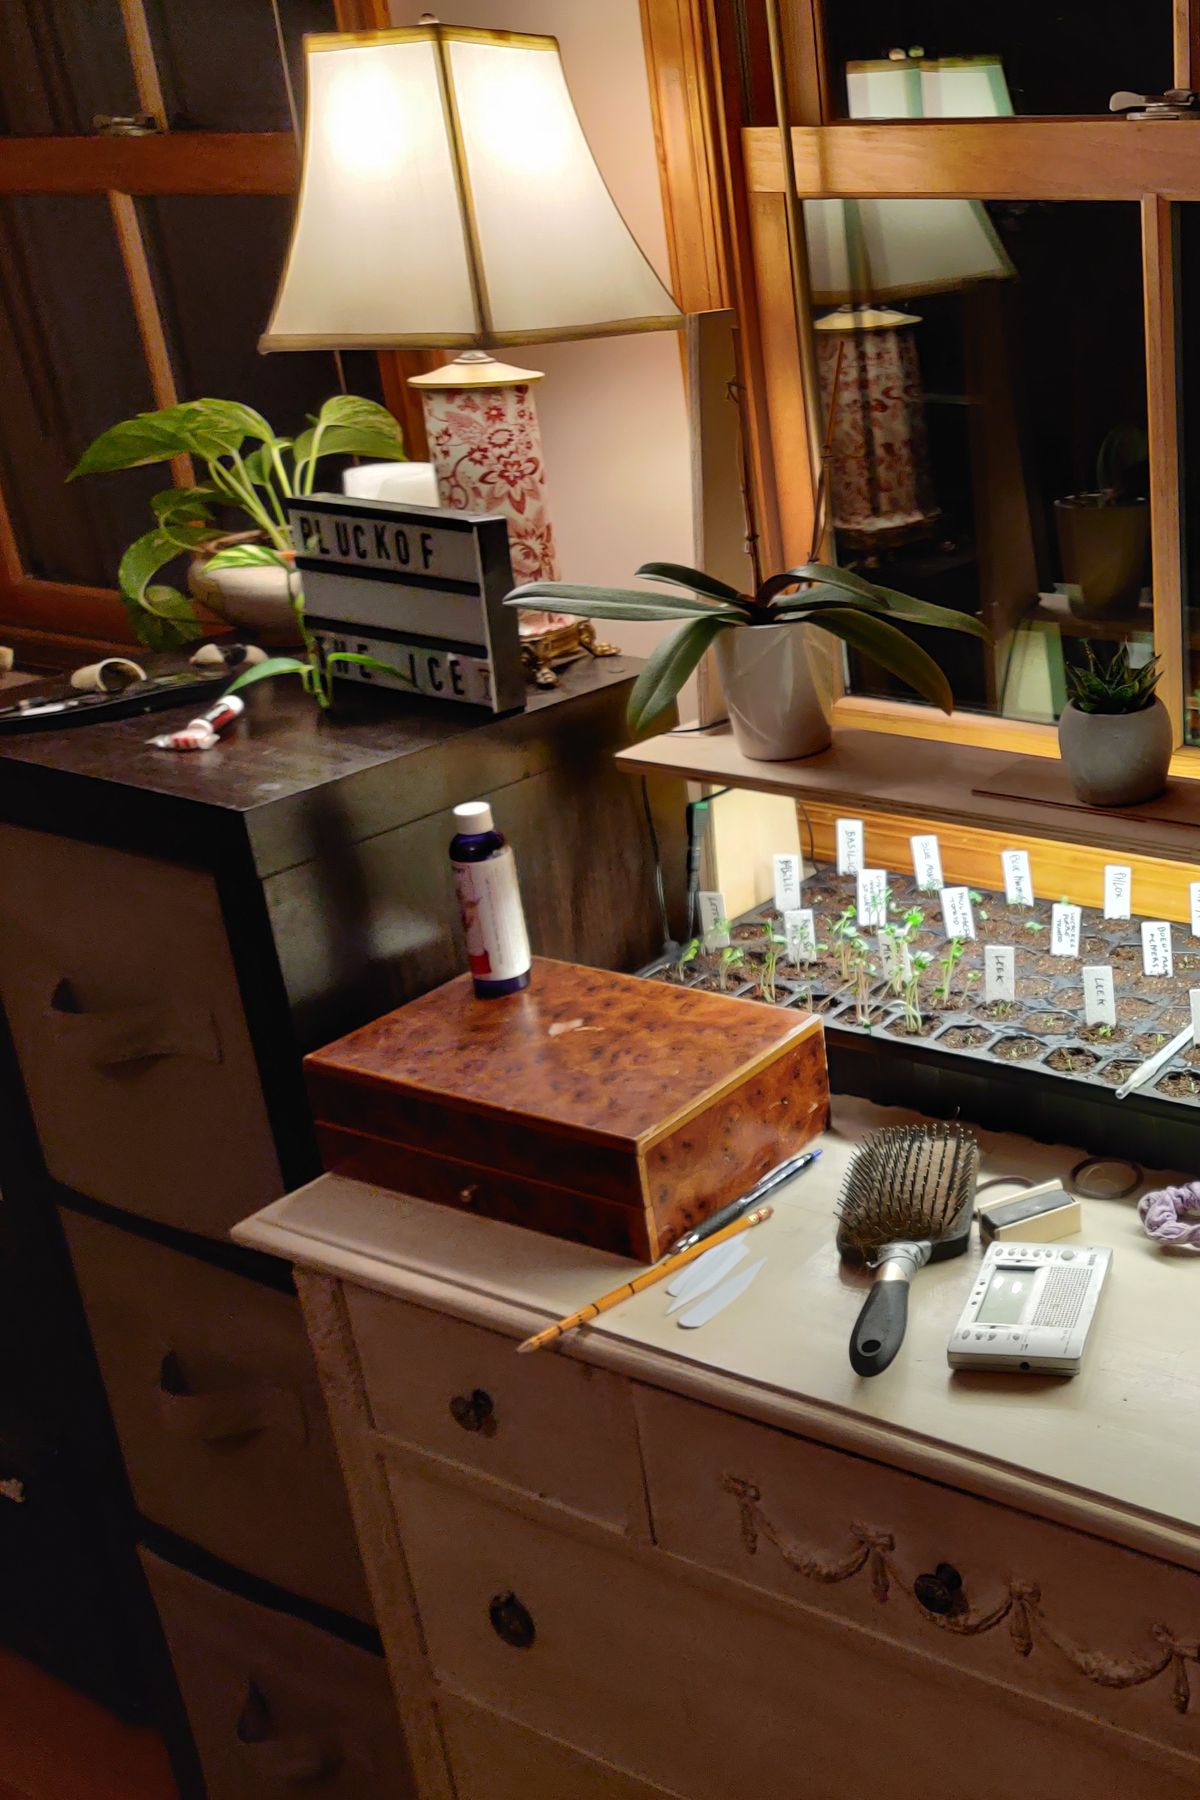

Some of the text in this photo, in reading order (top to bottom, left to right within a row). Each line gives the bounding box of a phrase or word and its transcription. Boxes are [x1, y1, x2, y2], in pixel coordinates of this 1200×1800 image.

[409, 653, 465, 696] ICE
[993, 955, 1007, 985] LEEK
[1094, 976, 1106, 1008] LEEK
